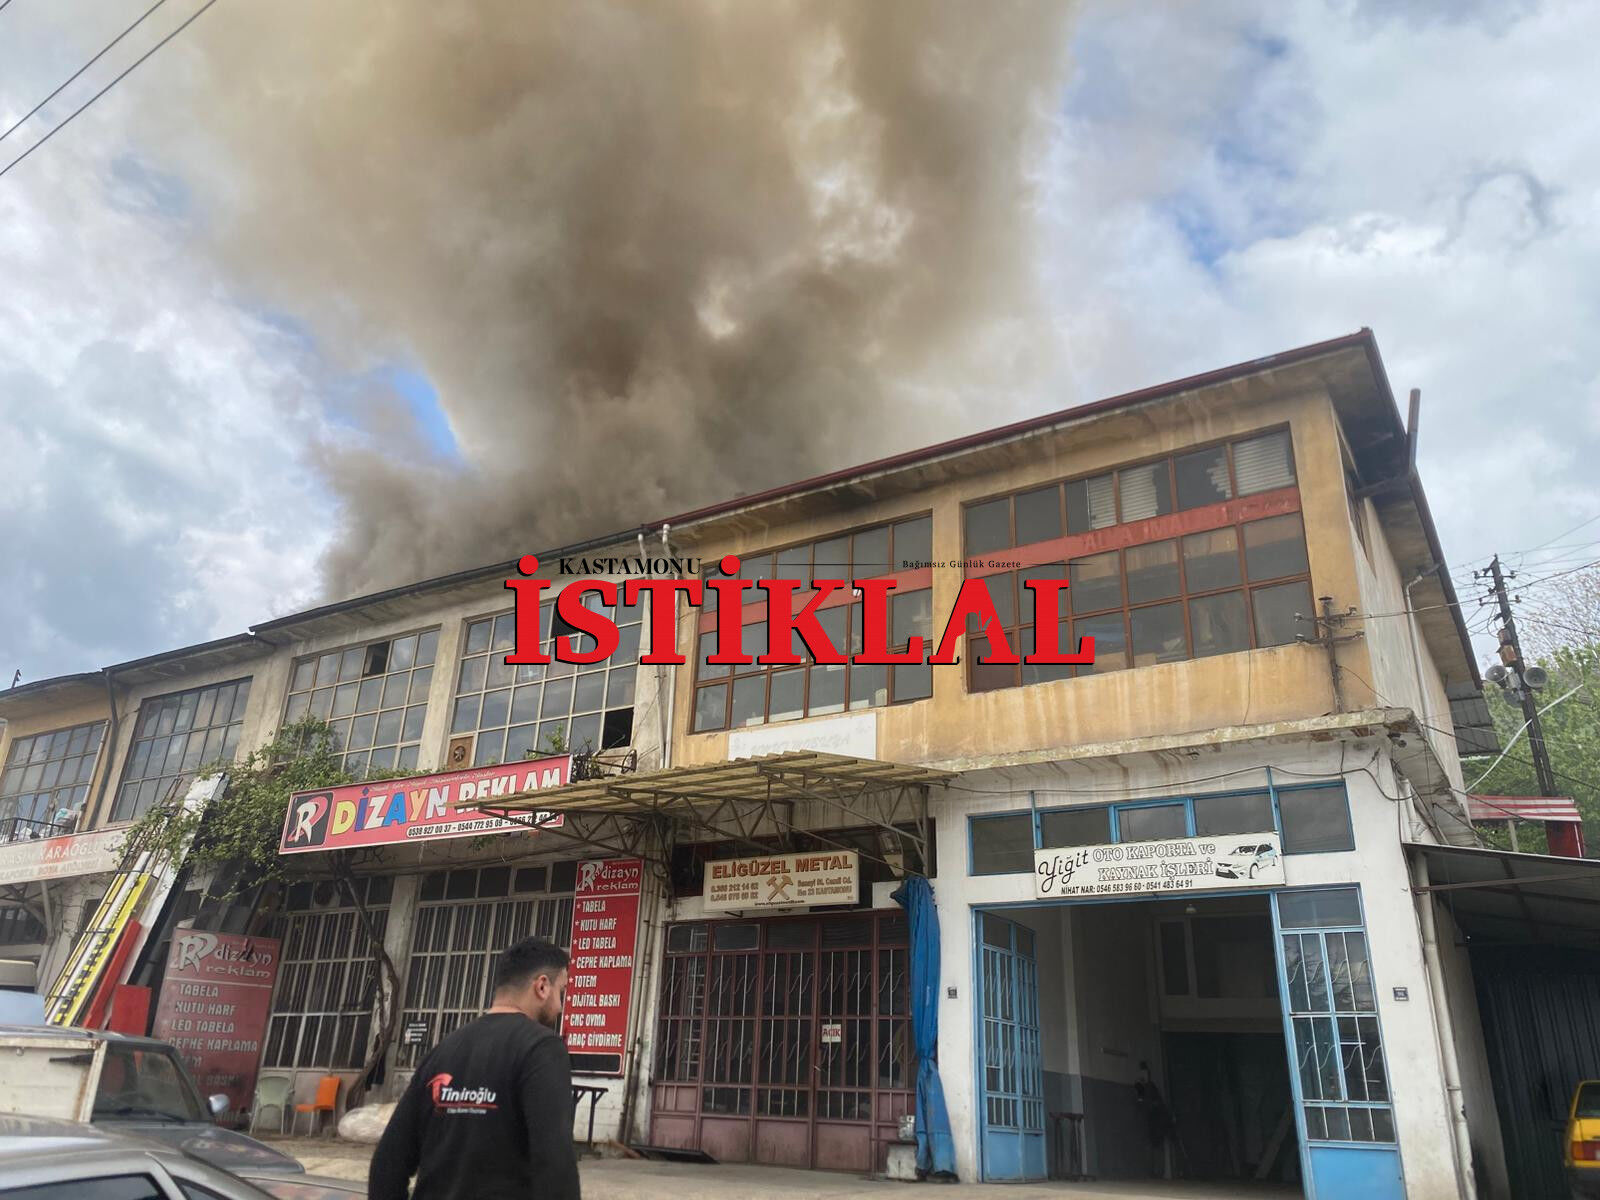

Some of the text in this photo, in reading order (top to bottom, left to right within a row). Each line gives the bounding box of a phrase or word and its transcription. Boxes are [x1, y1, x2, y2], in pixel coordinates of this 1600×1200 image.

[331, 785, 450, 836] DİZAYN
[457, 822, 472, 832] 0544
[474, 821, 484, 829] 772
[1092, 842, 1216, 862] OTO KAPORTA ve
[712, 855, 853, 879] ELİGÜZEL METAL
[1038, 849, 1089, 893] Yiğit
[1098, 856, 1214, 882] KAYNAK İŞLERİ
[601, 866, 639, 884] dizayn
[596, 881, 639, 891] reklam
[1061, 885, 1079, 895] NİHAT
[1081, 885, 1096, 894] NAR:
[1097, 884, 1112, 893] 0546
[582, 900, 606, 912] TABELA
[580, 918, 617, 931] KUTU HARF
[578, 937, 616, 950] LED TABELA
[599, 955, 632, 968] KAPLAMA
[205, 964, 271, 978] reklam
[574, 975, 597, 988] TOTEM
[179, 983, 219, 997] TABELA
[599, 994, 620, 1007] BASKI
[207, 1002, 237, 1016] HARF
[171, 1018, 235, 1033] LED TABELA
[585, 1013, 606, 1026] OYMA
[207, 1037, 258, 1052] KAPLAMA
[568, 1032, 622, 1048] ARAÇ GİYDİRME
